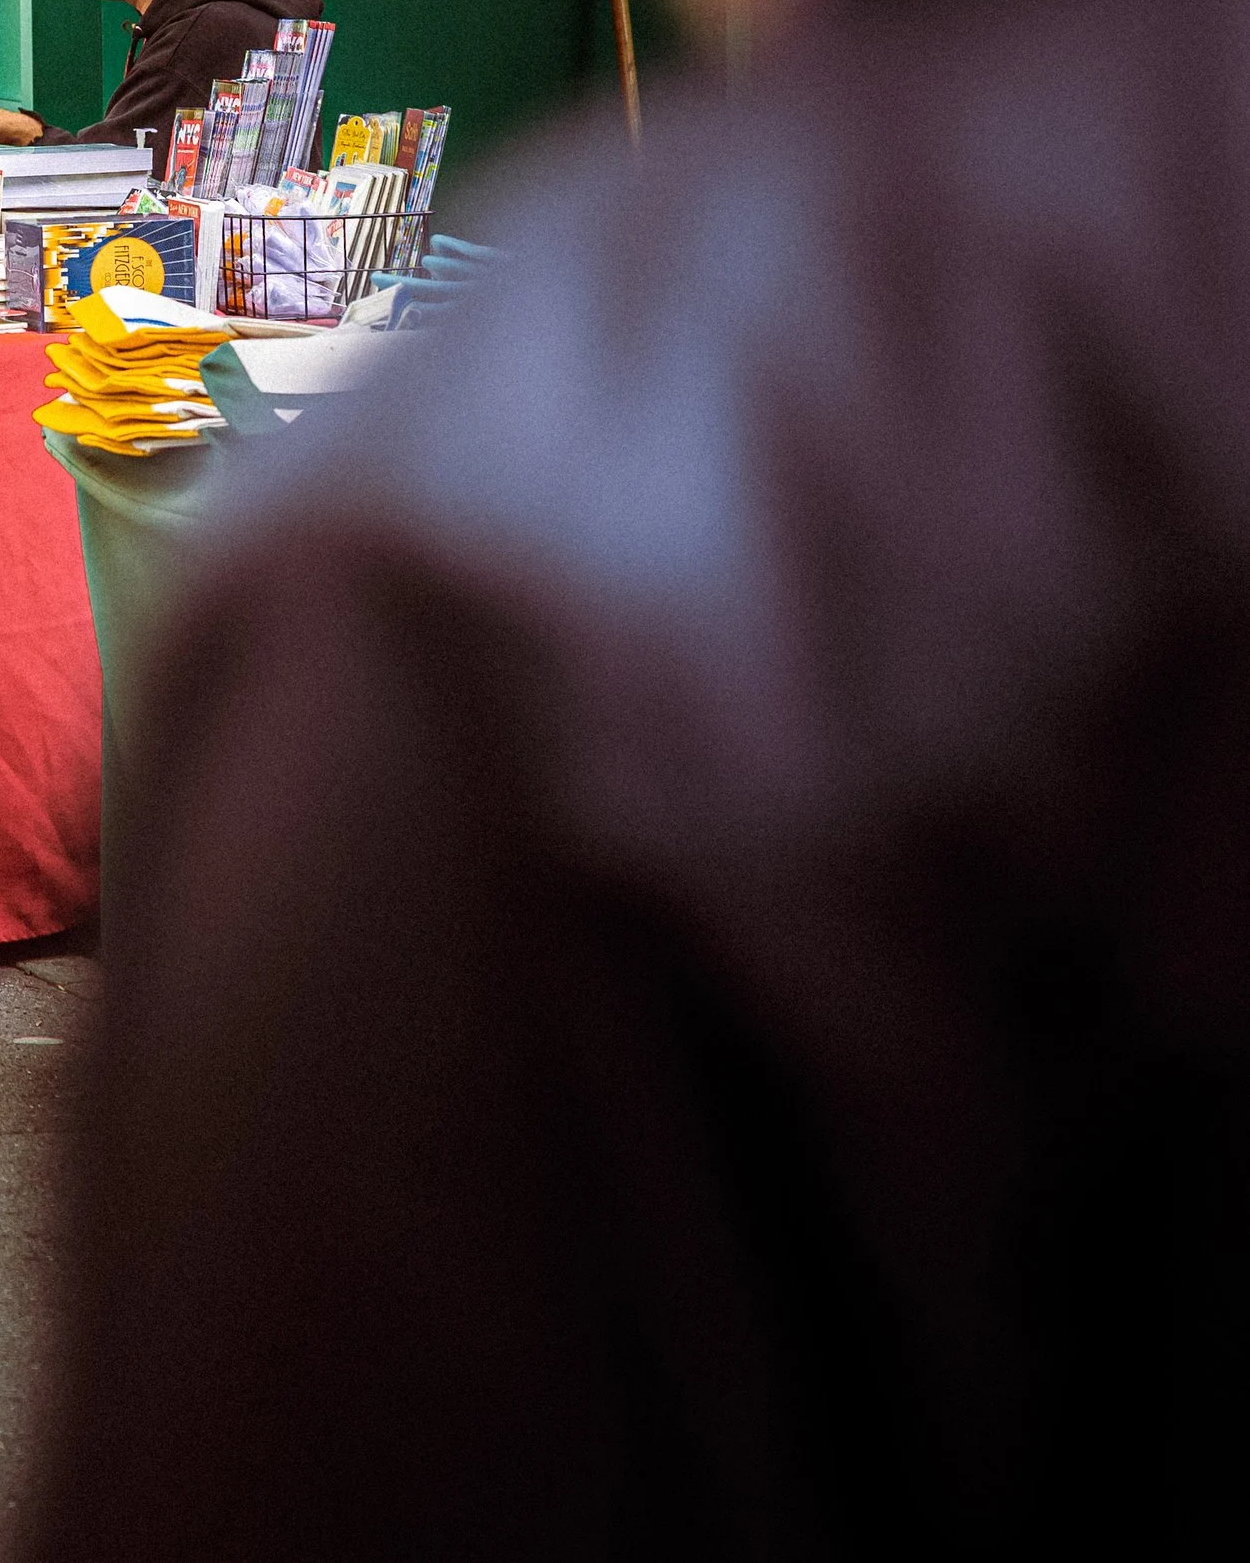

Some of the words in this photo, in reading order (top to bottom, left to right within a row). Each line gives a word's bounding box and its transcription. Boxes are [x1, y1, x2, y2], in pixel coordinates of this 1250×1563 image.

[216, 96, 241, 114] NYC
[176, 122, 201, 145] NYC
[113, 245, 131, 287] FITZGER
